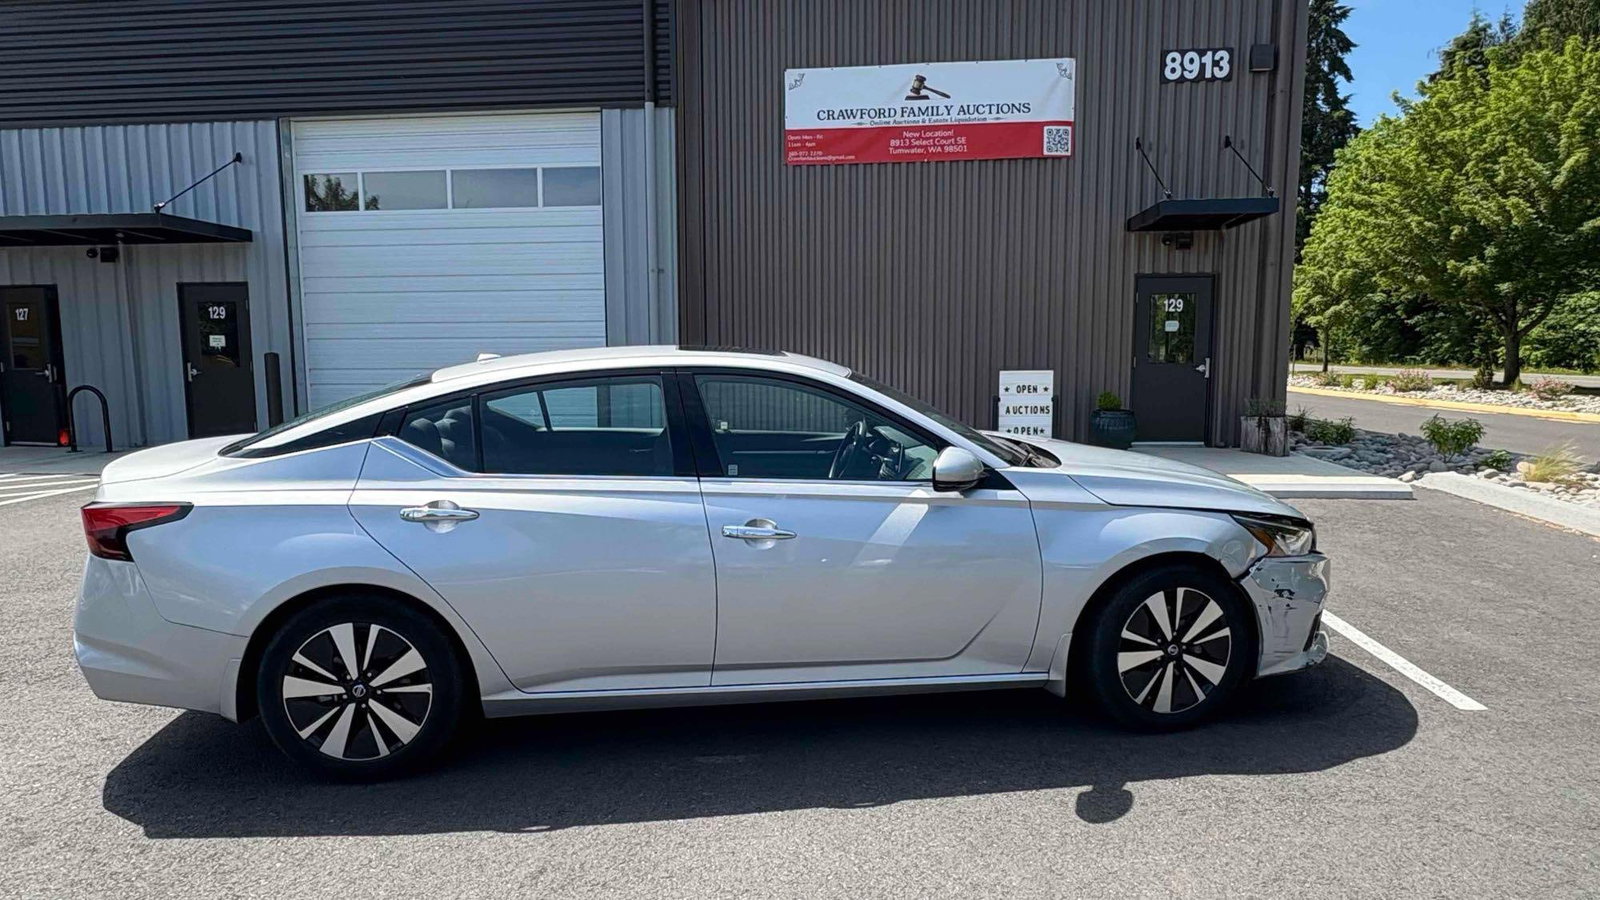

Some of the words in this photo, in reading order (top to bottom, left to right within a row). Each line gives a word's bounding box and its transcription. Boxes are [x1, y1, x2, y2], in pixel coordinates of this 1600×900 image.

[1164, 50, 1230, 80] 8913
[817, 107, 897, 121] CRAWFORD
[900, 105, 954, 118] FAMILY
[957, 102, 1031, 116] AUCTIONS
[928, 116, 948, 124] Estate
[950, 115, 987, 124] Liquidation
[921, 129, 954, 137] Location!
[889, 139, 909, 147] 8913
[911, 138, 933, 146] Select
[935, 137, 955, 145] Court
[957, 136, 967, 144] SE
[928, 145, 943, 153] WA
[944, 143, 968, 152] 98501
[1164, 298, 1184, 312] 129
[15, 307, 29, 321] 127
[208, 306, 226, 319] 129
[1016, 384, 1038, 394] OPEN
[1005, 405, 1050, 415] AUCTIONS
[1013, 426, 1039, 436] OPEN
